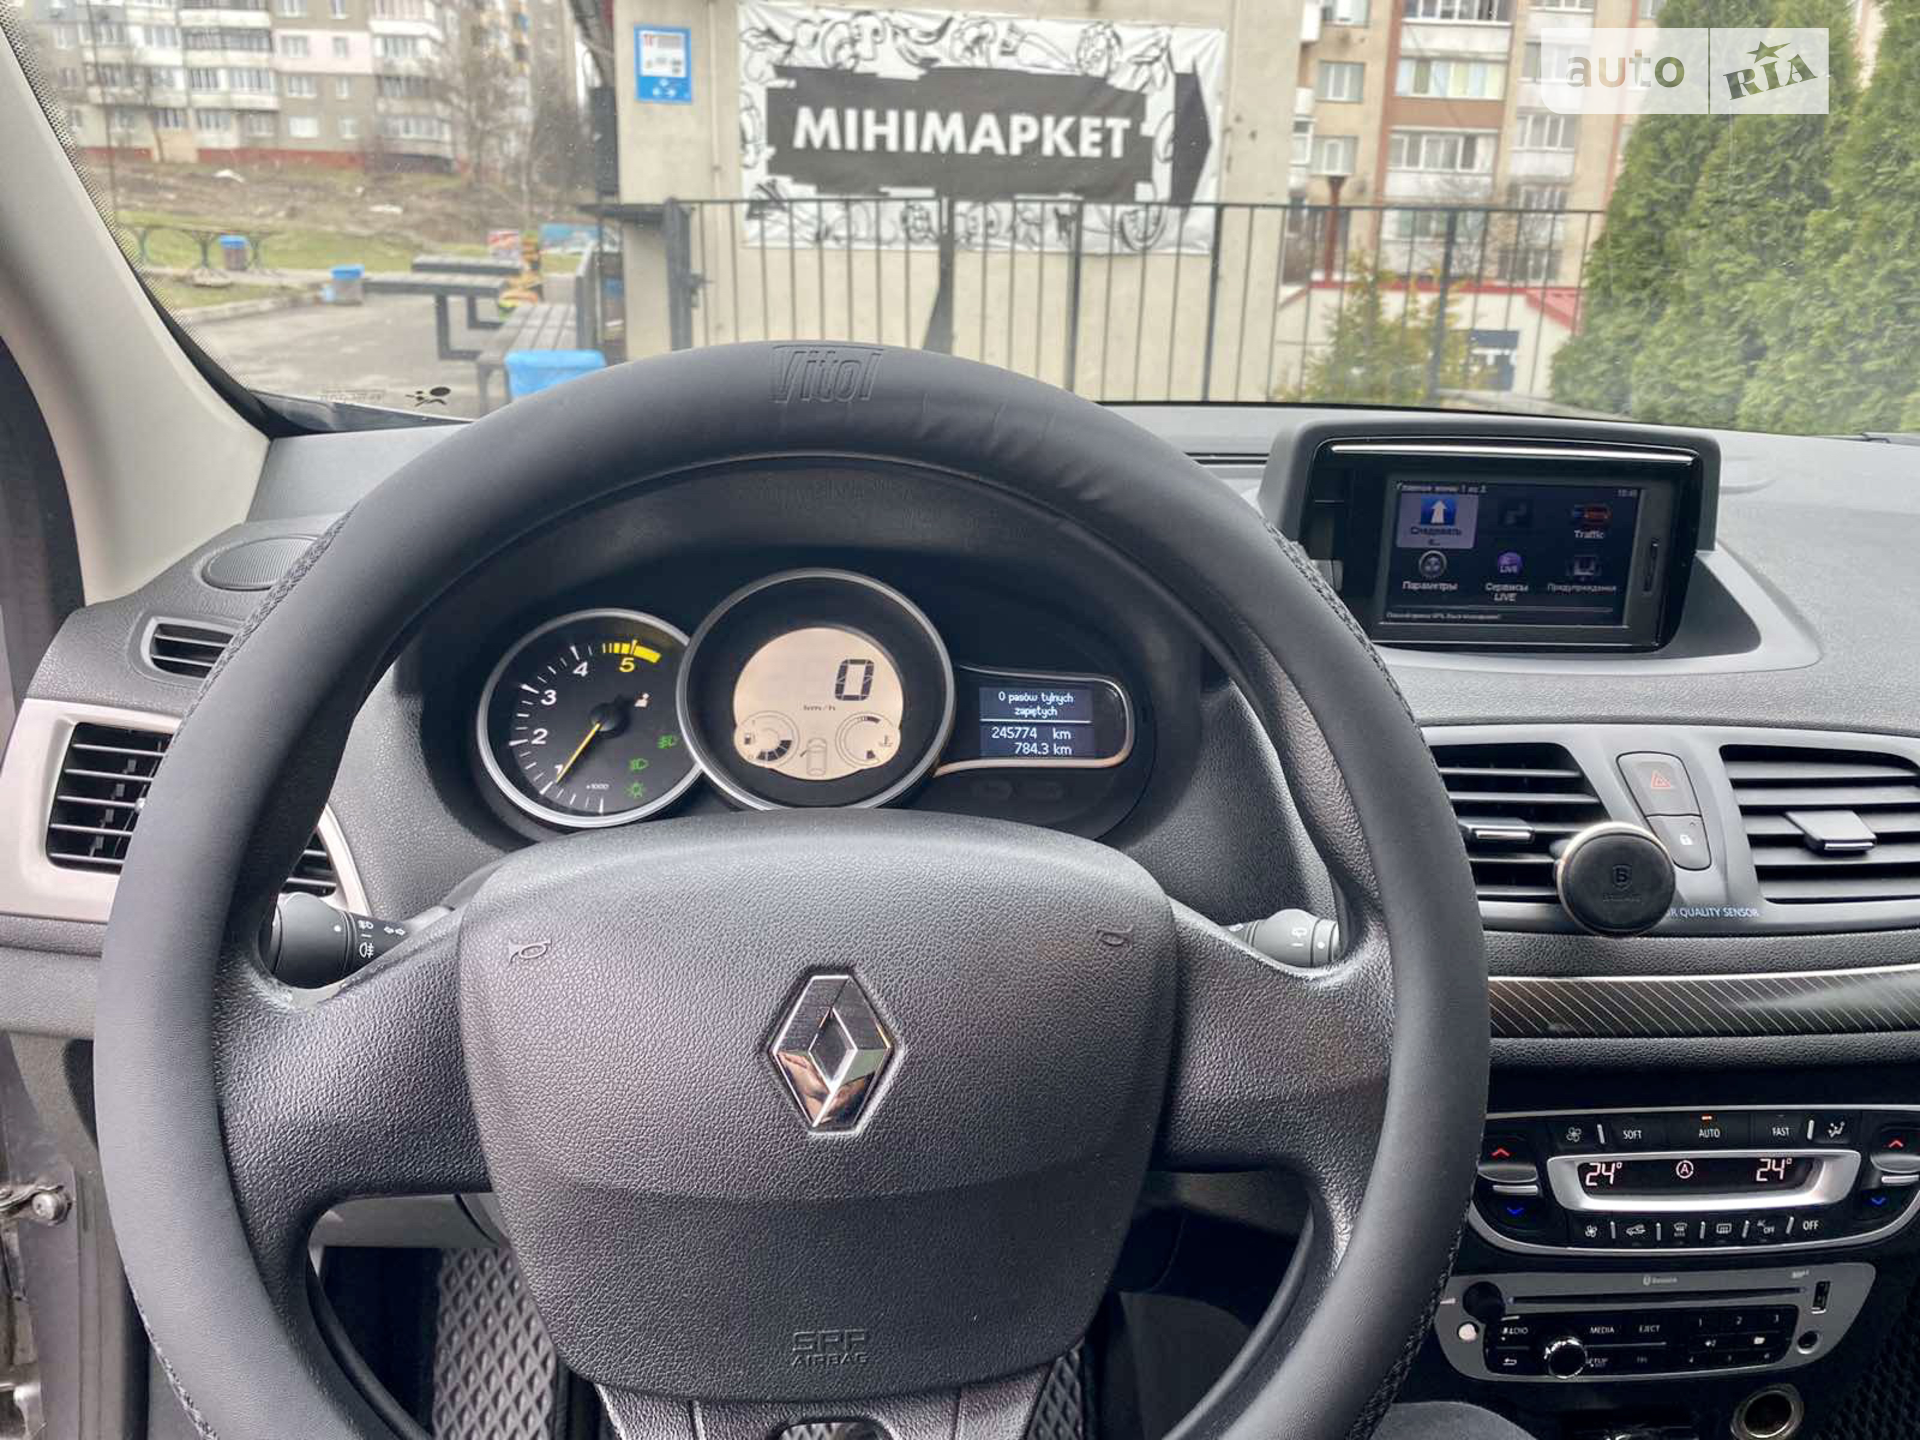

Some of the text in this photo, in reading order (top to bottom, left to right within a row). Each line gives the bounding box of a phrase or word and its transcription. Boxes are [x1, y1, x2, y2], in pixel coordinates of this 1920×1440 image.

[793, 106, 1131, 158] МІНІМАРКЕТ
[1574, 530, 1604, 539] Traffic
[1402, 581, 1458, 592] Параметры
[1485, 582, 1529, 593] Сервисы
[1493, 592, 1518, 601] LIVE
[573, 661, 589, 677] 4
[619, 657, 635, 673] 5
[834, 658, 875, 701] 0
[541, 690, 557, 706] 3
[998, 691, 1074, 705] 0 pasów tylnych
[1014, 706, 1058, 718] zapiętych
[531, 728, 548, 745] 2
[991, 726, 1072, 740] 245774 km
[1014, 742, 1073, 755] 784.3 km
[1680, 906, 1720, 918] QUALITY
[1722, 906, 1760, 918] SENSOR
[1622, 1129, 1643, 1140] SOFT
[1698, 1128, 1721, 1138] AUTO
[1772, 1127, 1790, 1136] FAST
[1802, 1220, 1819, 1231] OFF
[1590, 1326, 1615, 1335] MEDIA
[791, 1351, 868, 1365] AIRBAG
